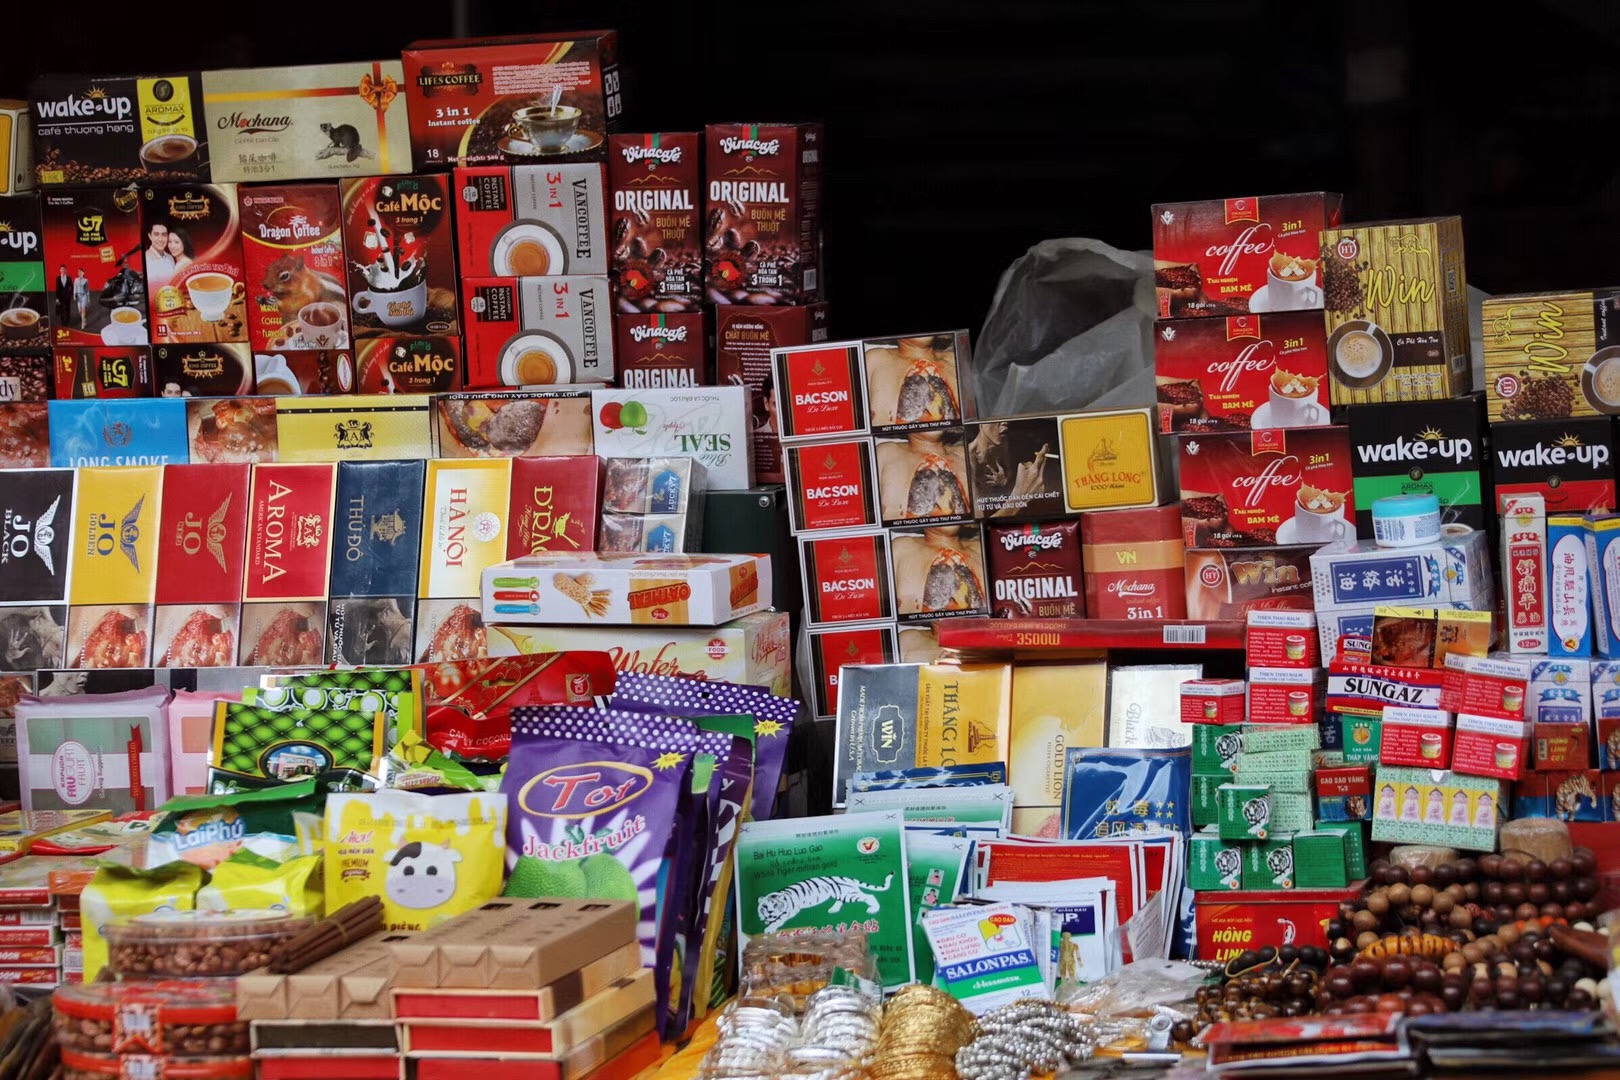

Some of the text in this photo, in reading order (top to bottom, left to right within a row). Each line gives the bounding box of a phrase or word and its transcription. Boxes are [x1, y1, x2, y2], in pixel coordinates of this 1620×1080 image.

[419, 74, 481, 86] LIFES COFFEE
[37, 94, 132, 120] wake-up
[145, 104, 185, 114] AROMAX
[428, 116, 481, 127] Instant coffee
[426, 148, 440, 158] 18
[546, 172, 562, 184] 3
[376, 193, 442, 215] Café Mộc
[484, 177, 492, 210] COFFEE
[490, 177, 500, 210] INSTANT
[550, 188, 557, 198] IN
[614, 189, 694, 212] ORIGINAL
[710, 180, 790, 204] ORIGINAL
[78, 214, 103, 232] G7
[572, 178, 592, 258] VANCOFFEE
[656, 215, 691, 228] BUÔN MÊ
[750, 208, 786, 221] BUÔN MÊ
[1282, 220, 1302, 232] 3in1
[259, 222, 320, 240] Dragon Coffee
[1205, 223, 1275, 276] coffee
[1342, 244, 1356, 254] HT
[554, 282, 568, 294] 3
[659, 281, 690, 293] 3 TRONG 1
[751, 274, 783, 286] 3 TRONG 1
[1367, 265, 1436, 310] Win
[490, 288, 499, 320] COFFEE
[498, 288, 506, 320] INSTANT
[556, 298, 564, 309] IN
[261, 317, 283, 325] COFFEE
[578, 288, 598, 368] VANCOFFEE
[1283, 338, 1304, 349] 3in1
[1524, 300, 1570, 373] Win
[389, 354, 454, 376] Café Mộc
[624, 368, 700, 388] ORIGINAL
[1206, 340, 1276, 392] coffee
[674, 433, 732, 452] SEAL
[1357, 436, 1472, 464] wake-up
[1498, 442, 1609, 469] wake-up
[1309, 452, 1330, 464] 3in1
[1232, 456, 1302, 508] coffee
[0, 508, 13, 564] BLACK
[10, 515, 31, 558] JO
[87, 513, 98, 557] GOLDEN
[96, 514, 116, 556] JO
[182, 512, 203, 556] JO
[262, 480, 294, 585] AROMA
[443, 486, 469, 568] HÀ NỘI
[254, 532, 262, 566] STANDARD
[1204, 571, 1217, 580] HT
[1230, 556, 1300, 585] Win
[995, 576, 1078, 601] ORIGINAL
[1038, 602, 1076, 616] BUÔN MÊ
[1016, 633, 1060, 646] MOOSE
[1344, 678, 1424, 704] SUNGAZ
[880, 720, 896, 749] WIN
[1125, 702, 1142, 745] Black
[78, 760, 86, 786] FRUIT
[1053, 734, 1064, 800] GOLD LION
[174, 816, 244, 850] LaiPhú
[522, 814, 647, 862] Jackfruit
[1212, 926, 1252, 943] HỒNG
[945, 952, 1030, 980] SALONPAS
